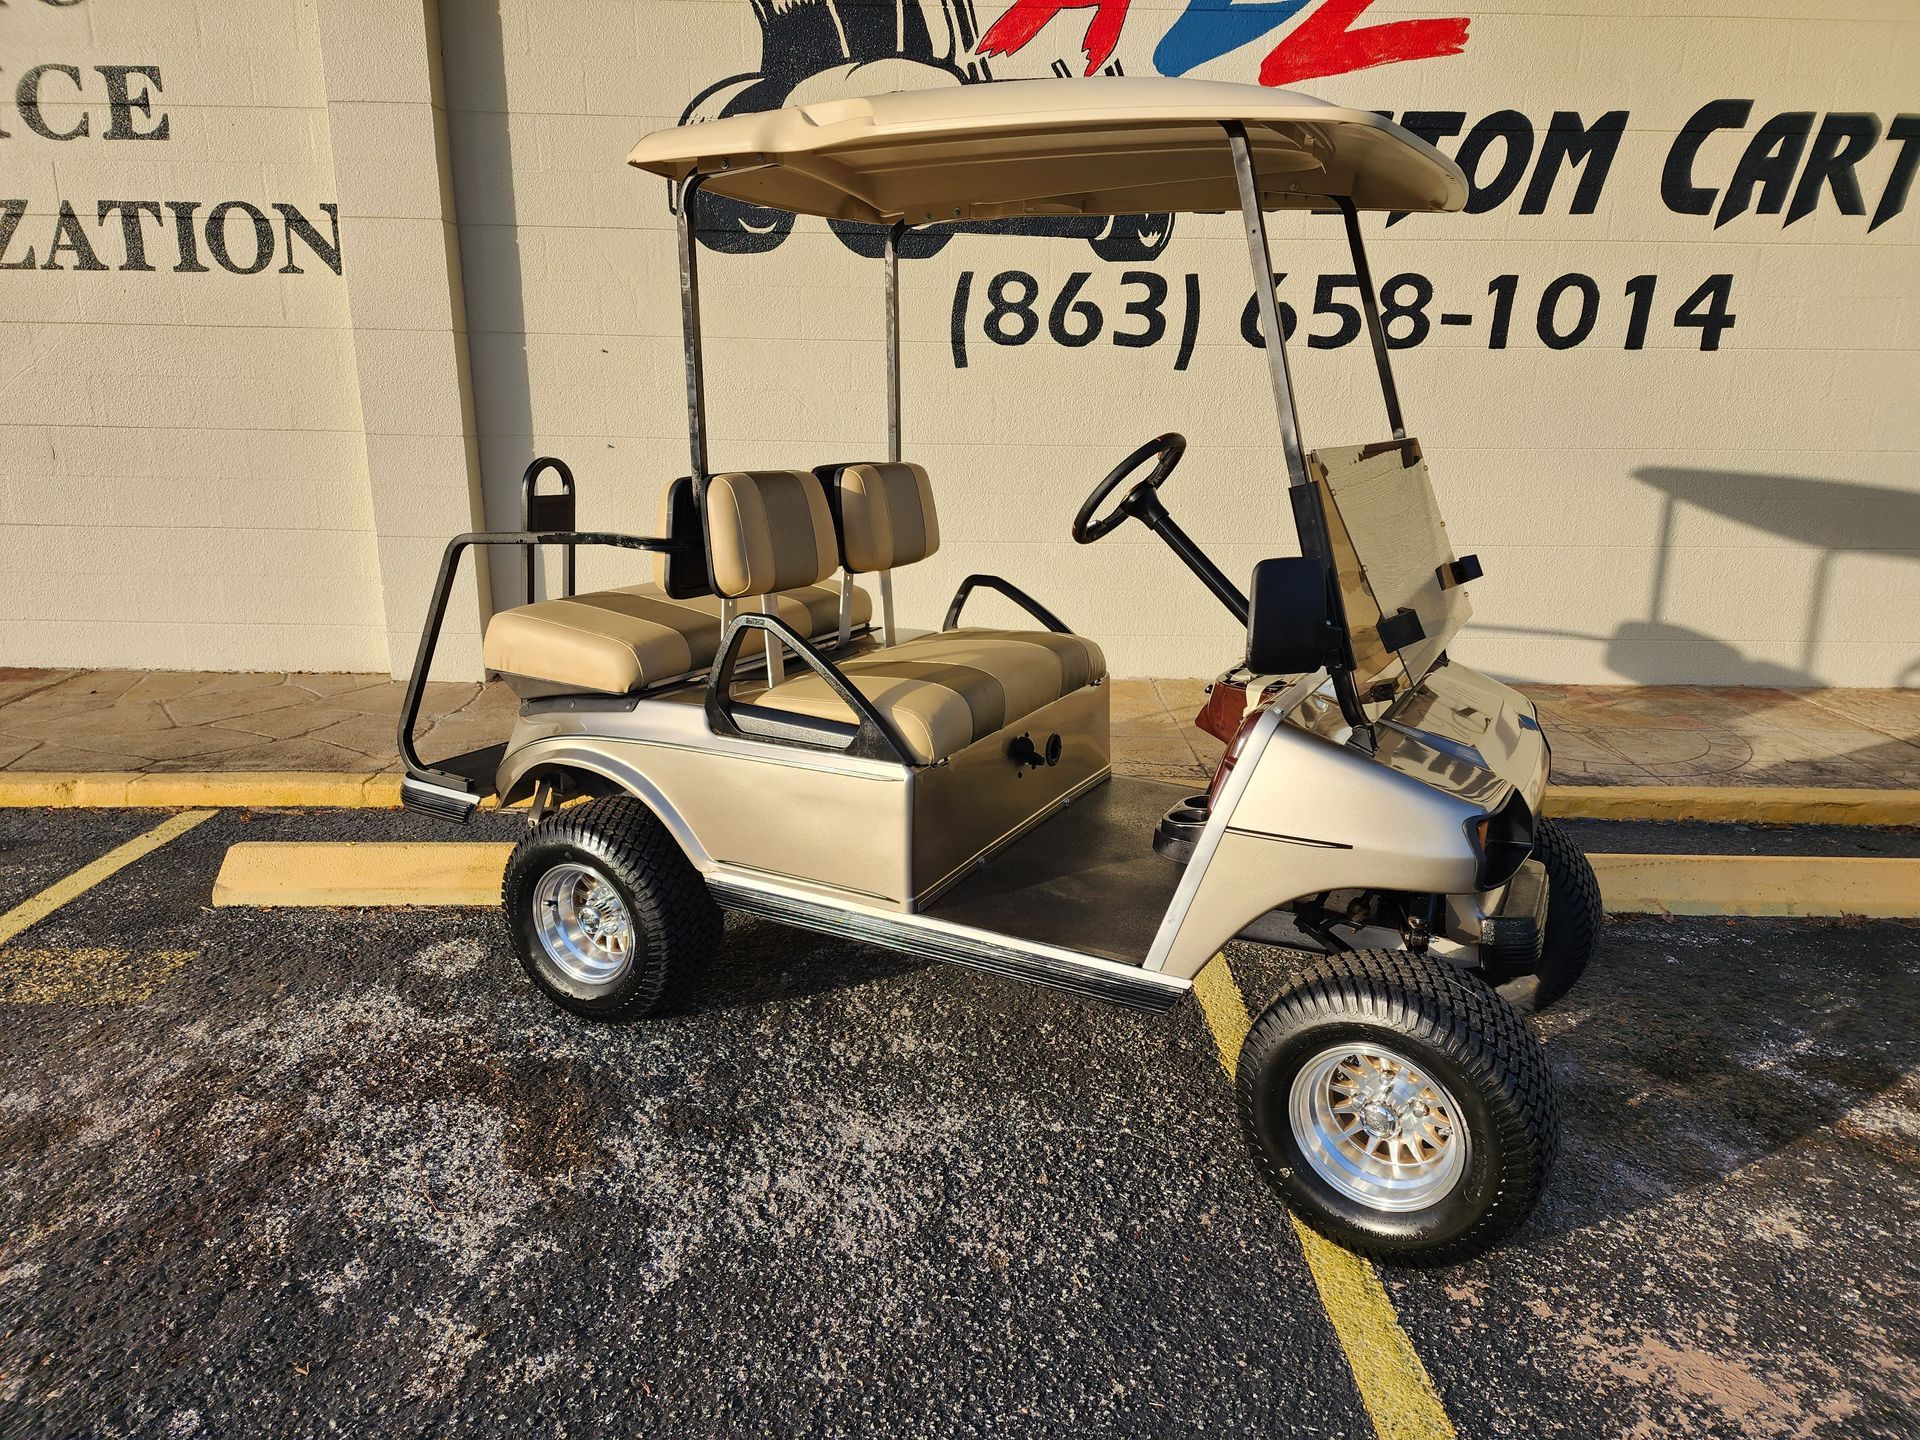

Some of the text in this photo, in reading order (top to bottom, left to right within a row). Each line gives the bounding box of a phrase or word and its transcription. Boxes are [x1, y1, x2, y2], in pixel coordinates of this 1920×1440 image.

[0, 64, 170, 140] CE
[1661, 99, 1920, 234] CART
[951, 270, 1736, 371] (863) 658-1014
